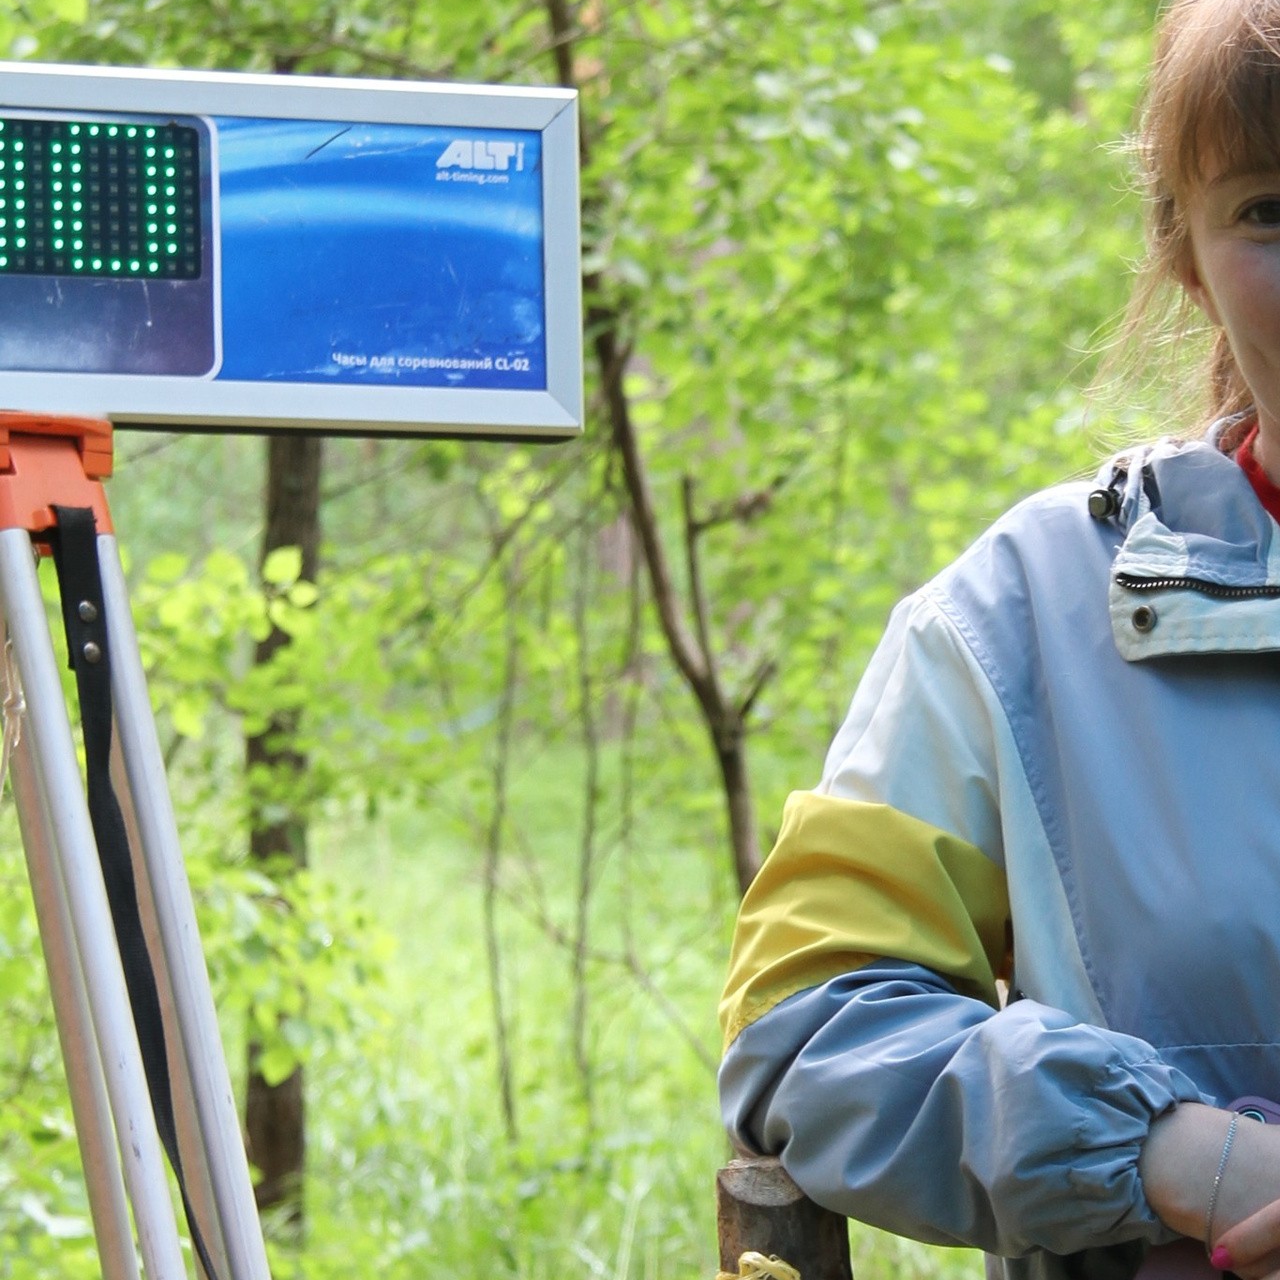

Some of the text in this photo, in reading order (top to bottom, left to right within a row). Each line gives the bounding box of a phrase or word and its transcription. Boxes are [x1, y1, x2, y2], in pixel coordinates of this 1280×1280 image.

[332, 353, 530, 371] Часы для соревнований CL-02
